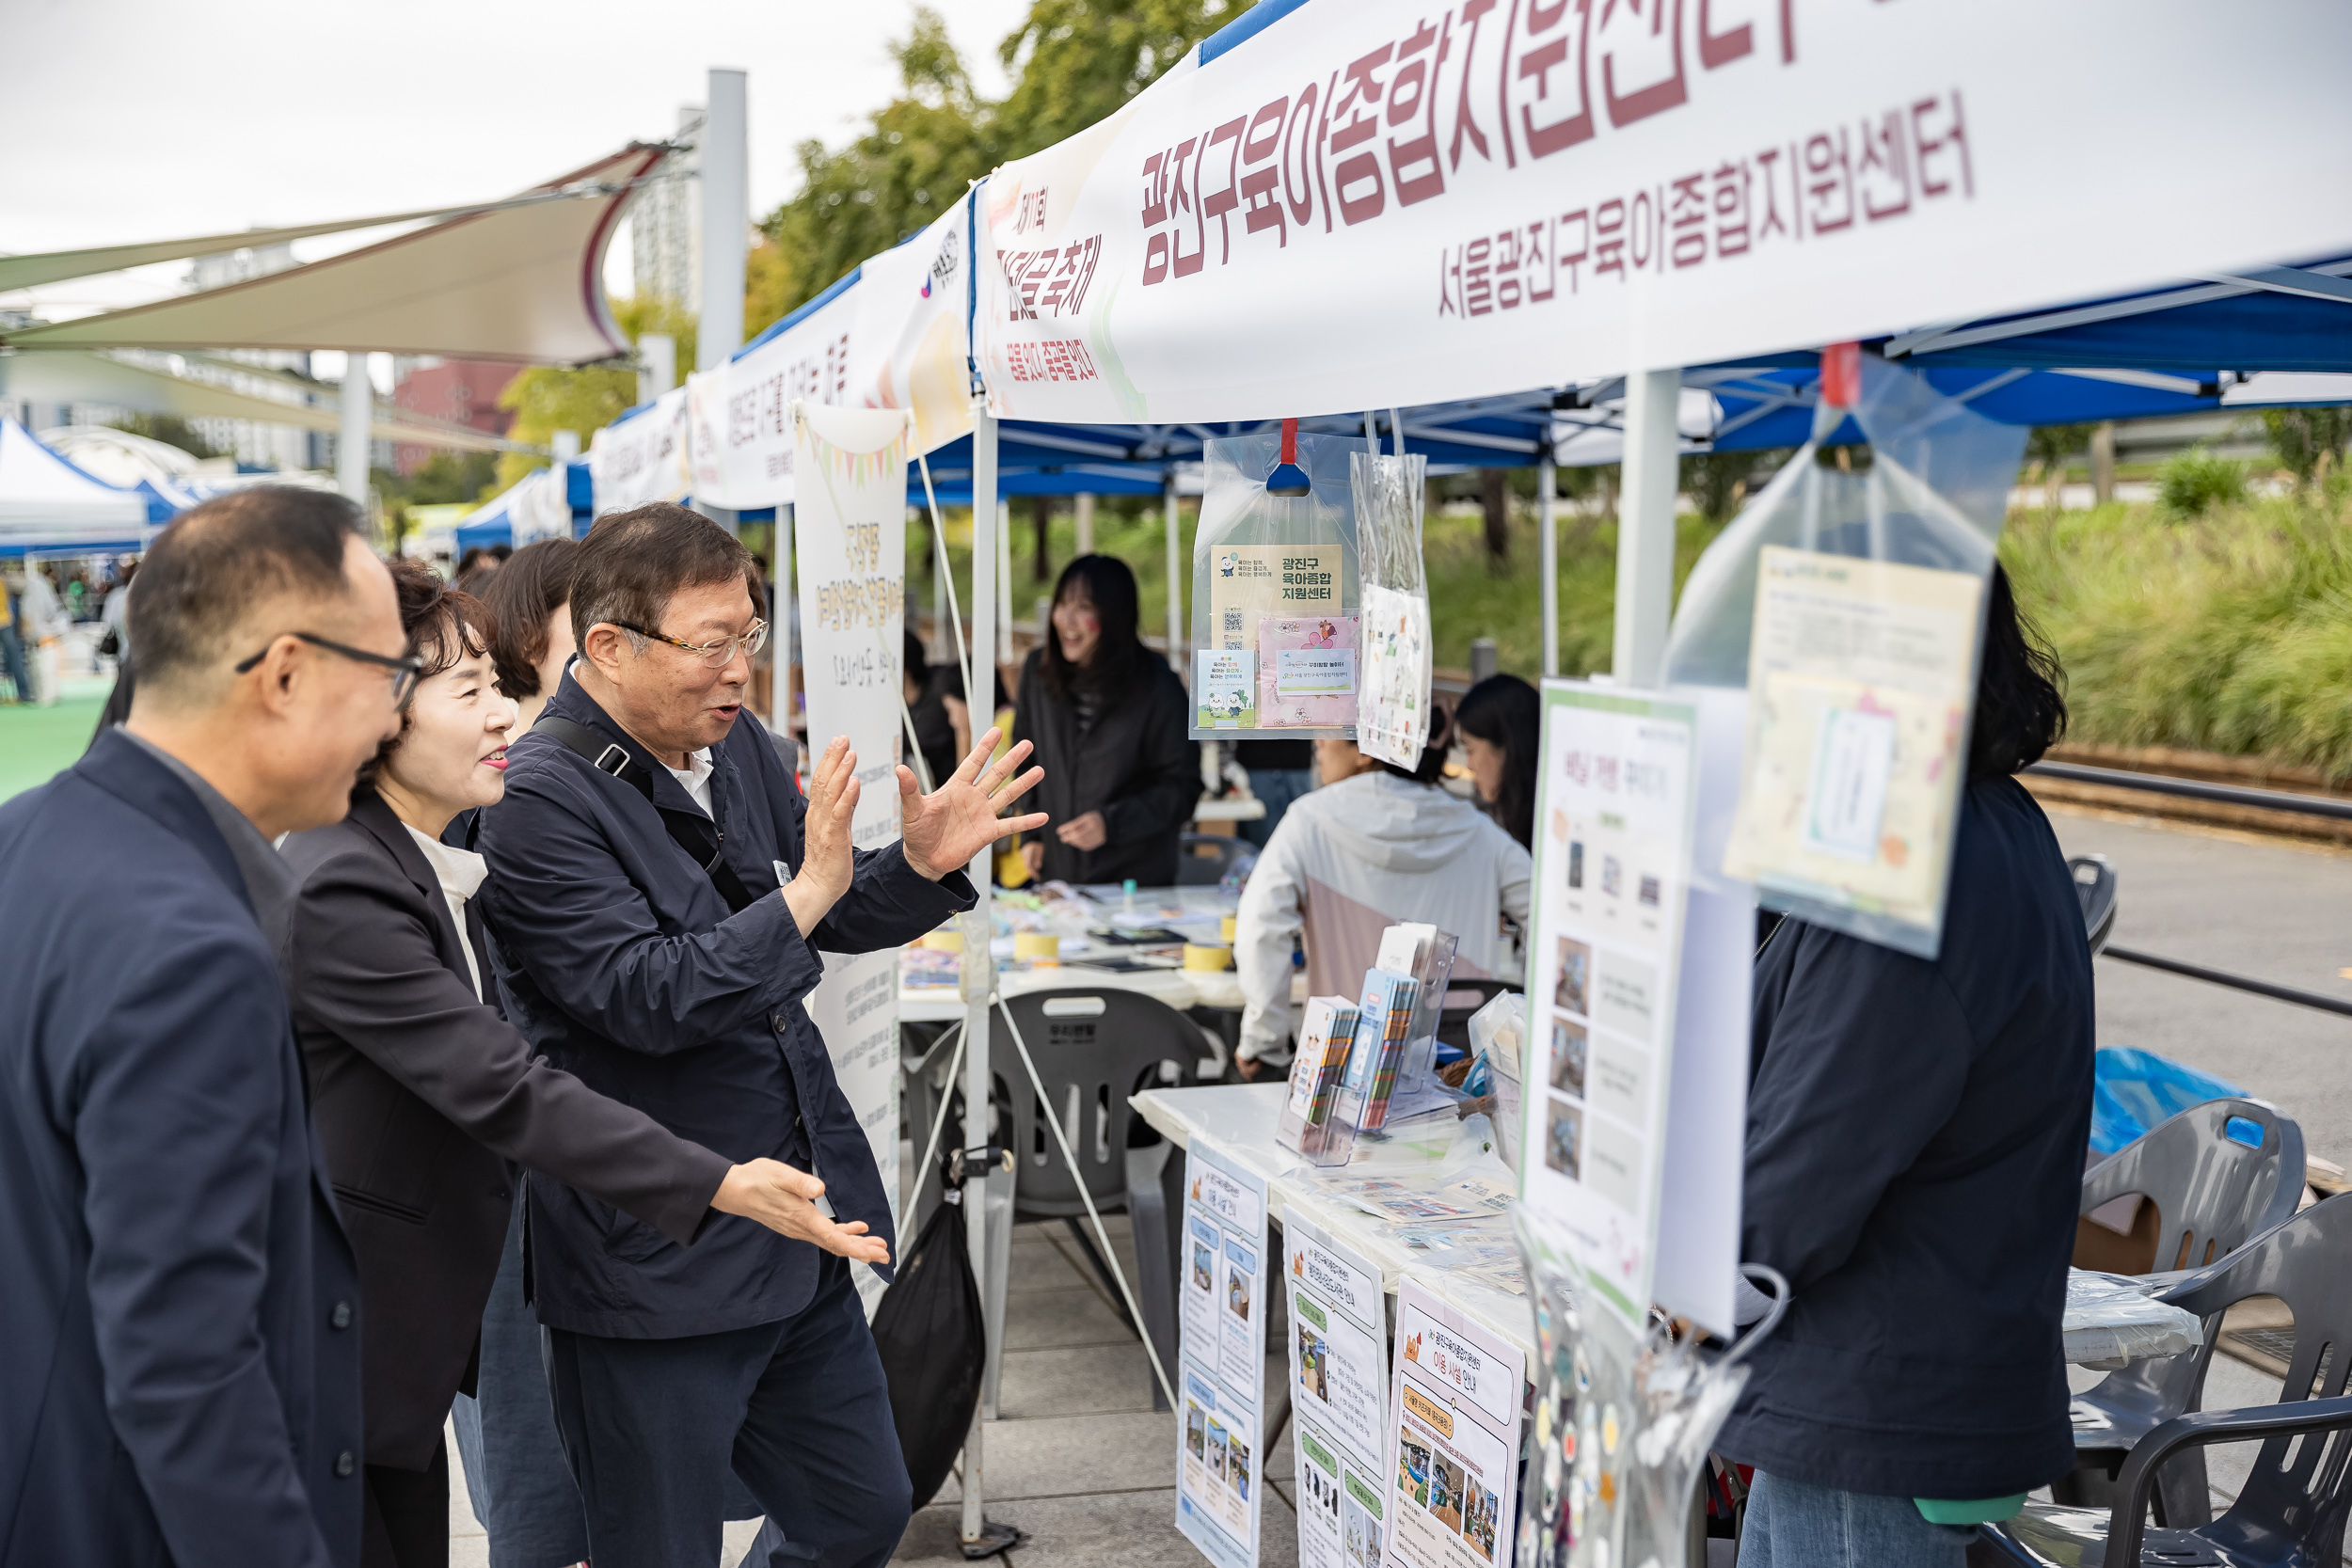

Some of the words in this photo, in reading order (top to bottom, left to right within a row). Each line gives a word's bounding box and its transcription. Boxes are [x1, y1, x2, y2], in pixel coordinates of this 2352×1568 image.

[1011, 185, 1048, 235] 제11회
[1438, 90, 1975, 320] 서울광진구육아종합지원센터
[1041, 233, 1102, 318] 축제
[1282, 558, 1319, 571] 광진구
[1282, 572, 1331, 585] 육아종합
[1281, 587, 1331, 600] 지원센터
[1435, 1331, 1481, 1372] 광진구육아종합지원센터
[1433, 1351, 1446, 1375] 이용
[1448, 1361, 1462, 1386] 시설
[1462, 1370, 1477, 1395] 안내
